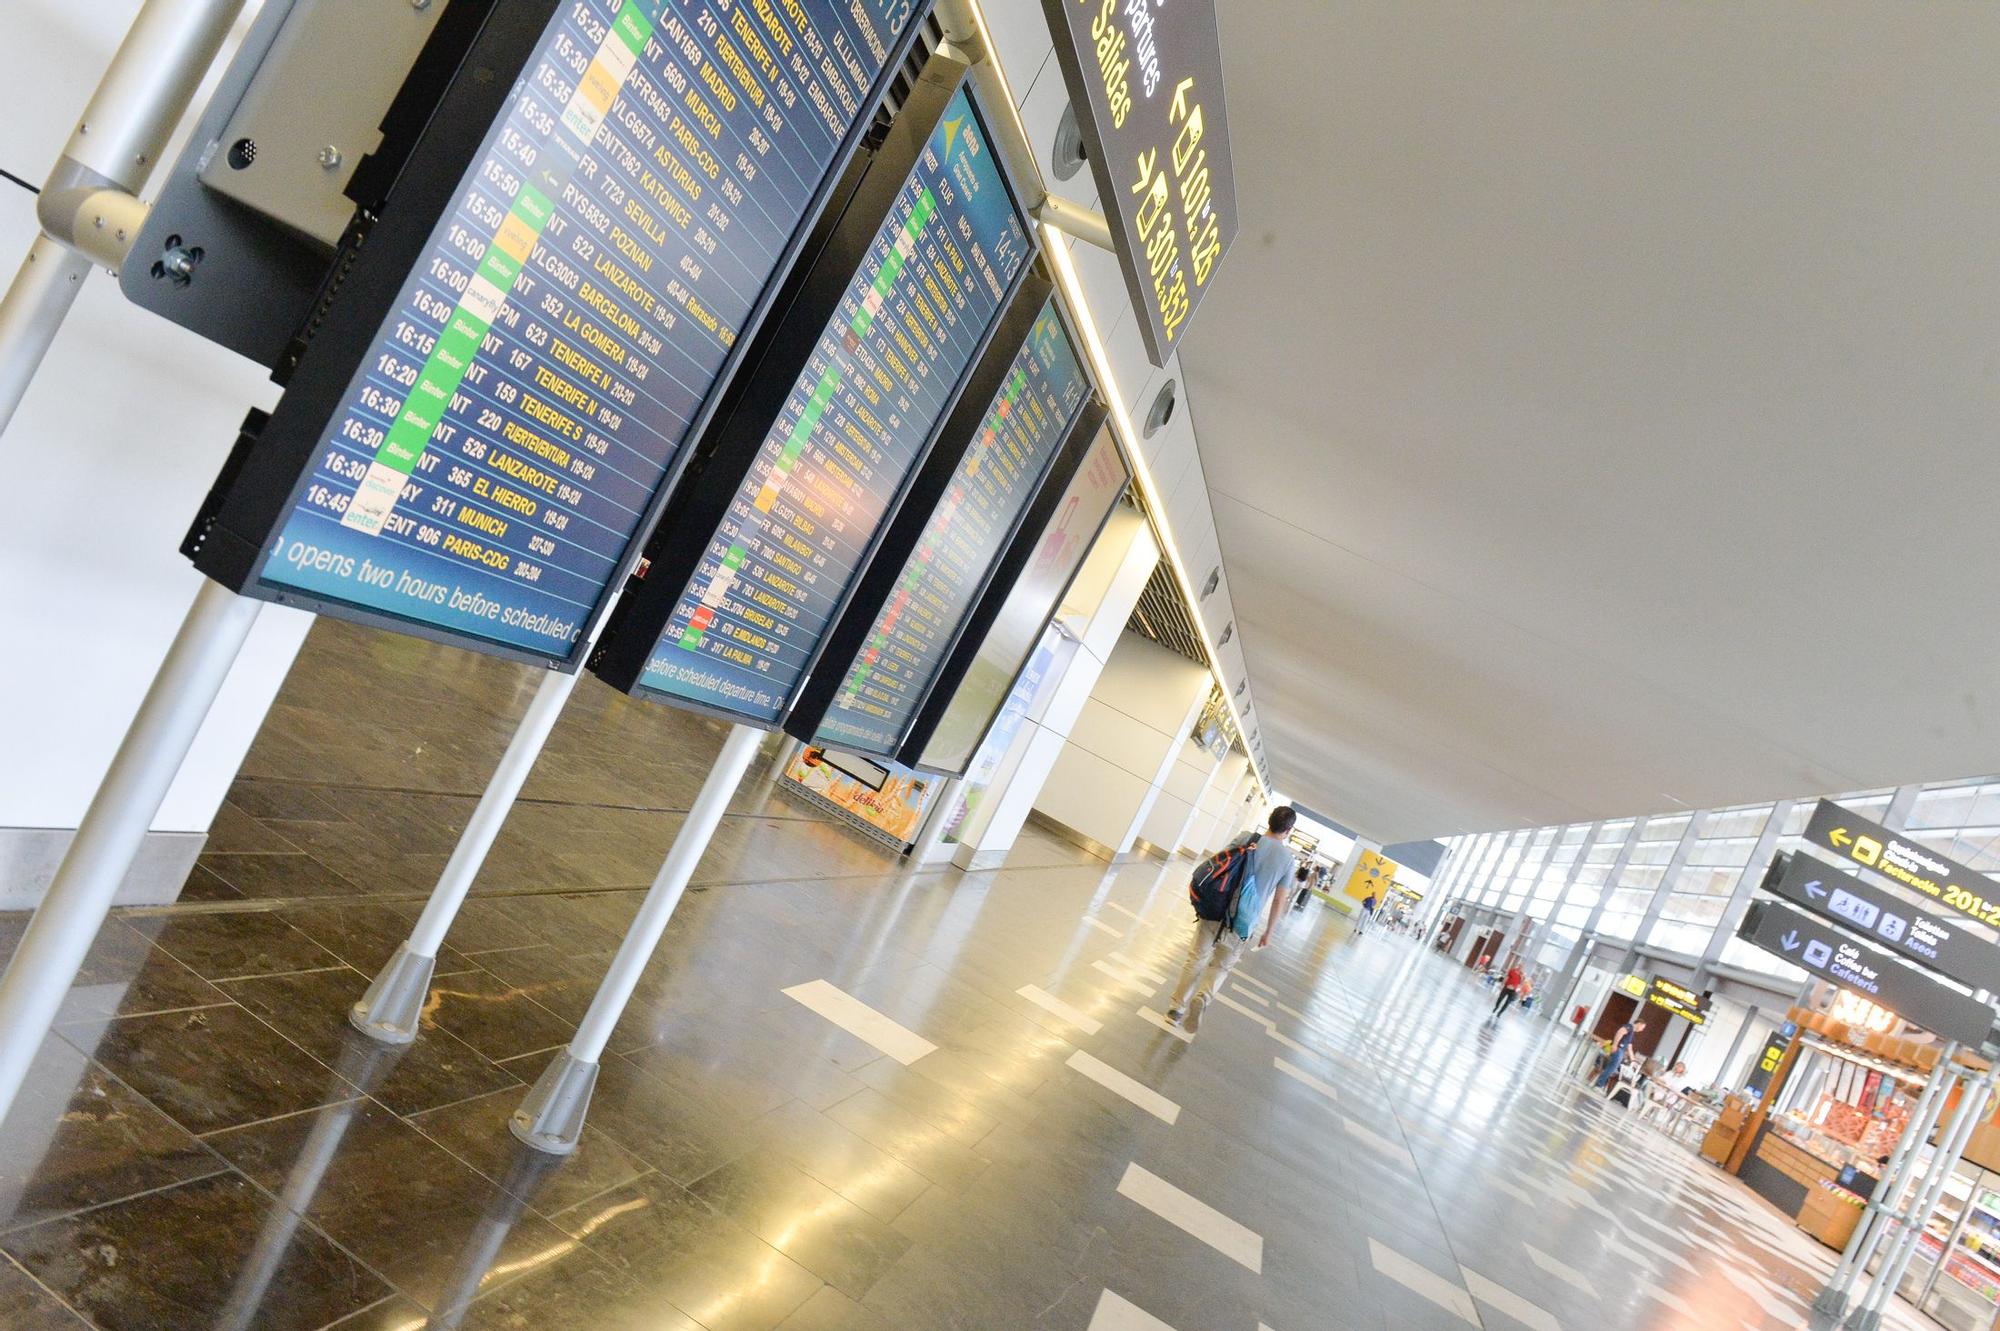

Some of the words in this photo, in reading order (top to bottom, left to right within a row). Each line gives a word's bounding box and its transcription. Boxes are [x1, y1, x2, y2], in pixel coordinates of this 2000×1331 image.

[695, 7, 717, 41] 210
[713, 32, 766, 110] FUERTEVENTURA
[728, 6, 772, 74] TENERIFE
[767, 63, 779, 84] N
[831, 29, 871, 99] UL.LLAMADA
[848, 0, 887, 70] OBSERVACIONES
[1092, 0, 1131, 128] Salidas
[551, 30, 588, 78] 15:30
[653, 142, 702, 203] ASTURIAS
[568, 0, 606, 48] 15:25
[667, 114, 720, 181] PARIS-CDG
[641, 35, 663, 67] NT
[682, 86, 723, 141] MURCIA
[698, 59, 737, 114] MADRID
[806, 78, 845, 141] EMBARQUE
[819, 54, 857, 119] EMBARQUE
[515, 93, 555, 139] 15:35
[577, 152, 599, 182] FR
[598, 173, 626, 208] 7723
[622, 196, 668, 248] SEVILLA
[533, 60, 572, 108] 15:35
[593, 122, 642, 179] ENT7362
[637, 168, 692, 231] KATOWICE
[961, 122, 980, 159] aena
[937, 177, 954, 207] FLUG
[957, 213, 973, 241] NACH
[1181, 150, 1210, 232] 101
[462, 189, 504, 232] 15:50
[527, 241, 580, 292] VLG3003
[577, 280, 642, 340] BARCELONA
[480, 157, 521, 201] 15:50
[544, 212, 567, 240] NT
[570, 233, 595, 263] 522
[592, 253, 655, 313] LANZAROTE
[498, 125, 538, 170] 15:40
[607, 225, 653, 273] POZNAN
[684, 295, 719, 333] Retrasado
[926, 208, 937, 227] NT
[935, 223, 947, 243] 311
[942, 236, 953, 254] LA
[948, 246, 964, 275] PALMA
[991, 225, 1021, 283] 14:13
[1148, 212, 1178, 290] 301
[1192, 213, 1220, 286] 126
[444, 222, 487, 263] 16:00
[485, 254, 513, 281] Binter
[511, 271, 536, 298] NT
[539, 292, 565, 319] 352
[562, 309, 583, 333] LA
[578, 321, 628, 365] GOMERA
[932, 255, 958, 298] LANZAROTE
[1160, 270, 1188, 342] 352
[409, 287, 452, 326] 16:00
[452, 317, 480, 342] Binter
[479, 332, 504, 358] NT
[506, 347, 532, 373] 167
[532, 365, 589, 410] TENERIFE
[585, 398, 599, 416] N
[596, 406, 623, 431] 119-124
[426, 255, 470, 295] 16:00
[495, 302, 521, 329] PM
[522, 321, 549, 349] 623
[546, 337, 603, 385] TENERIFE
[598, 372, 612, 391] N
[892, 328, 919, 365] HANNOVER
[373, 352, 419, 389] 16:20
[419, 378, 448, 402] Binter
[446, 391, 472, 416] NT
[476, 407, 504, 433] 220
[500, 420, 572, 469] FUERTEVENTURA
[568, 457, 596, 481] 119-124
[391, 319, 436, 357] 16:15
[435, 347, 464, 371] Binter
[462, 361, 488, 387] NT
[491, 379, 519, 405] 159
[517, 393, 575, 437] TENERIFE
[570, 424, 584, 442] S
[582, 431, 610, 456] 119-124
[853, 402, 882, 436] LANZAROTE
[862, 384, 880, 407] ROMA
[338, 417, 385, 451] 16:30
[385, 441, 415, 463] Binter
[414, 451, 441, 475] NT
[445, 465, 474, 489] 365
[471, 476, 494, 498] EL
[489, 485, 538, 517] HIERRO
[540, 508, 570, 531] 119-124
[356, 384, 402, 419] 16:30
[402, 409, 432, 432] Binter
[430, 421, 456, 446] NT
[460, 435, 489, 461] 526
[486, 448, 559, 495] LANZAROTE
[554, 482, 583, 506] 119-124
[302, 482, 351, 515] 16:45
[344, 508, 380, 531] enter
[381, 511, 417, 538] ENT
[413, 523, 443, 547] 906
[441, 533, 512, 571] PARIS-CDG
[320, 450, 368, 483] 16:30
[397, 481, 422, 504] 4Y
[429, 494, 457, 518] 311
[455, 505, 509, 538] MUNICH
[280, 539, 357, 583] opens
[353, 558, 398, 590] two
[393, 569, 452, 605] hours
[446, 586, 504, 620] before
[498, 602, 579, 642] scheduled
[761, 571, 796, 597] LANZAROTE
[771, 551, 802, 576] SANTIAGO
[741, 607, 774, 630] BRUSELAS
[675, 663, 722, 691] scheduled
[714, 679, 757, 707] departure
[721, 645, 734, 659] LA
[728, 648, 753, 666] PALMA
[1878, 858, 1940, 896] Facturación
[1942, 885, 1982, 917] 201
[1830, 964, 1878, 994] Cafetería
[1834, 954, 1862, 972] Coffee
[1862, 966, 1878, 980] bar
[1904, 937, 1937, 958] Aseos
